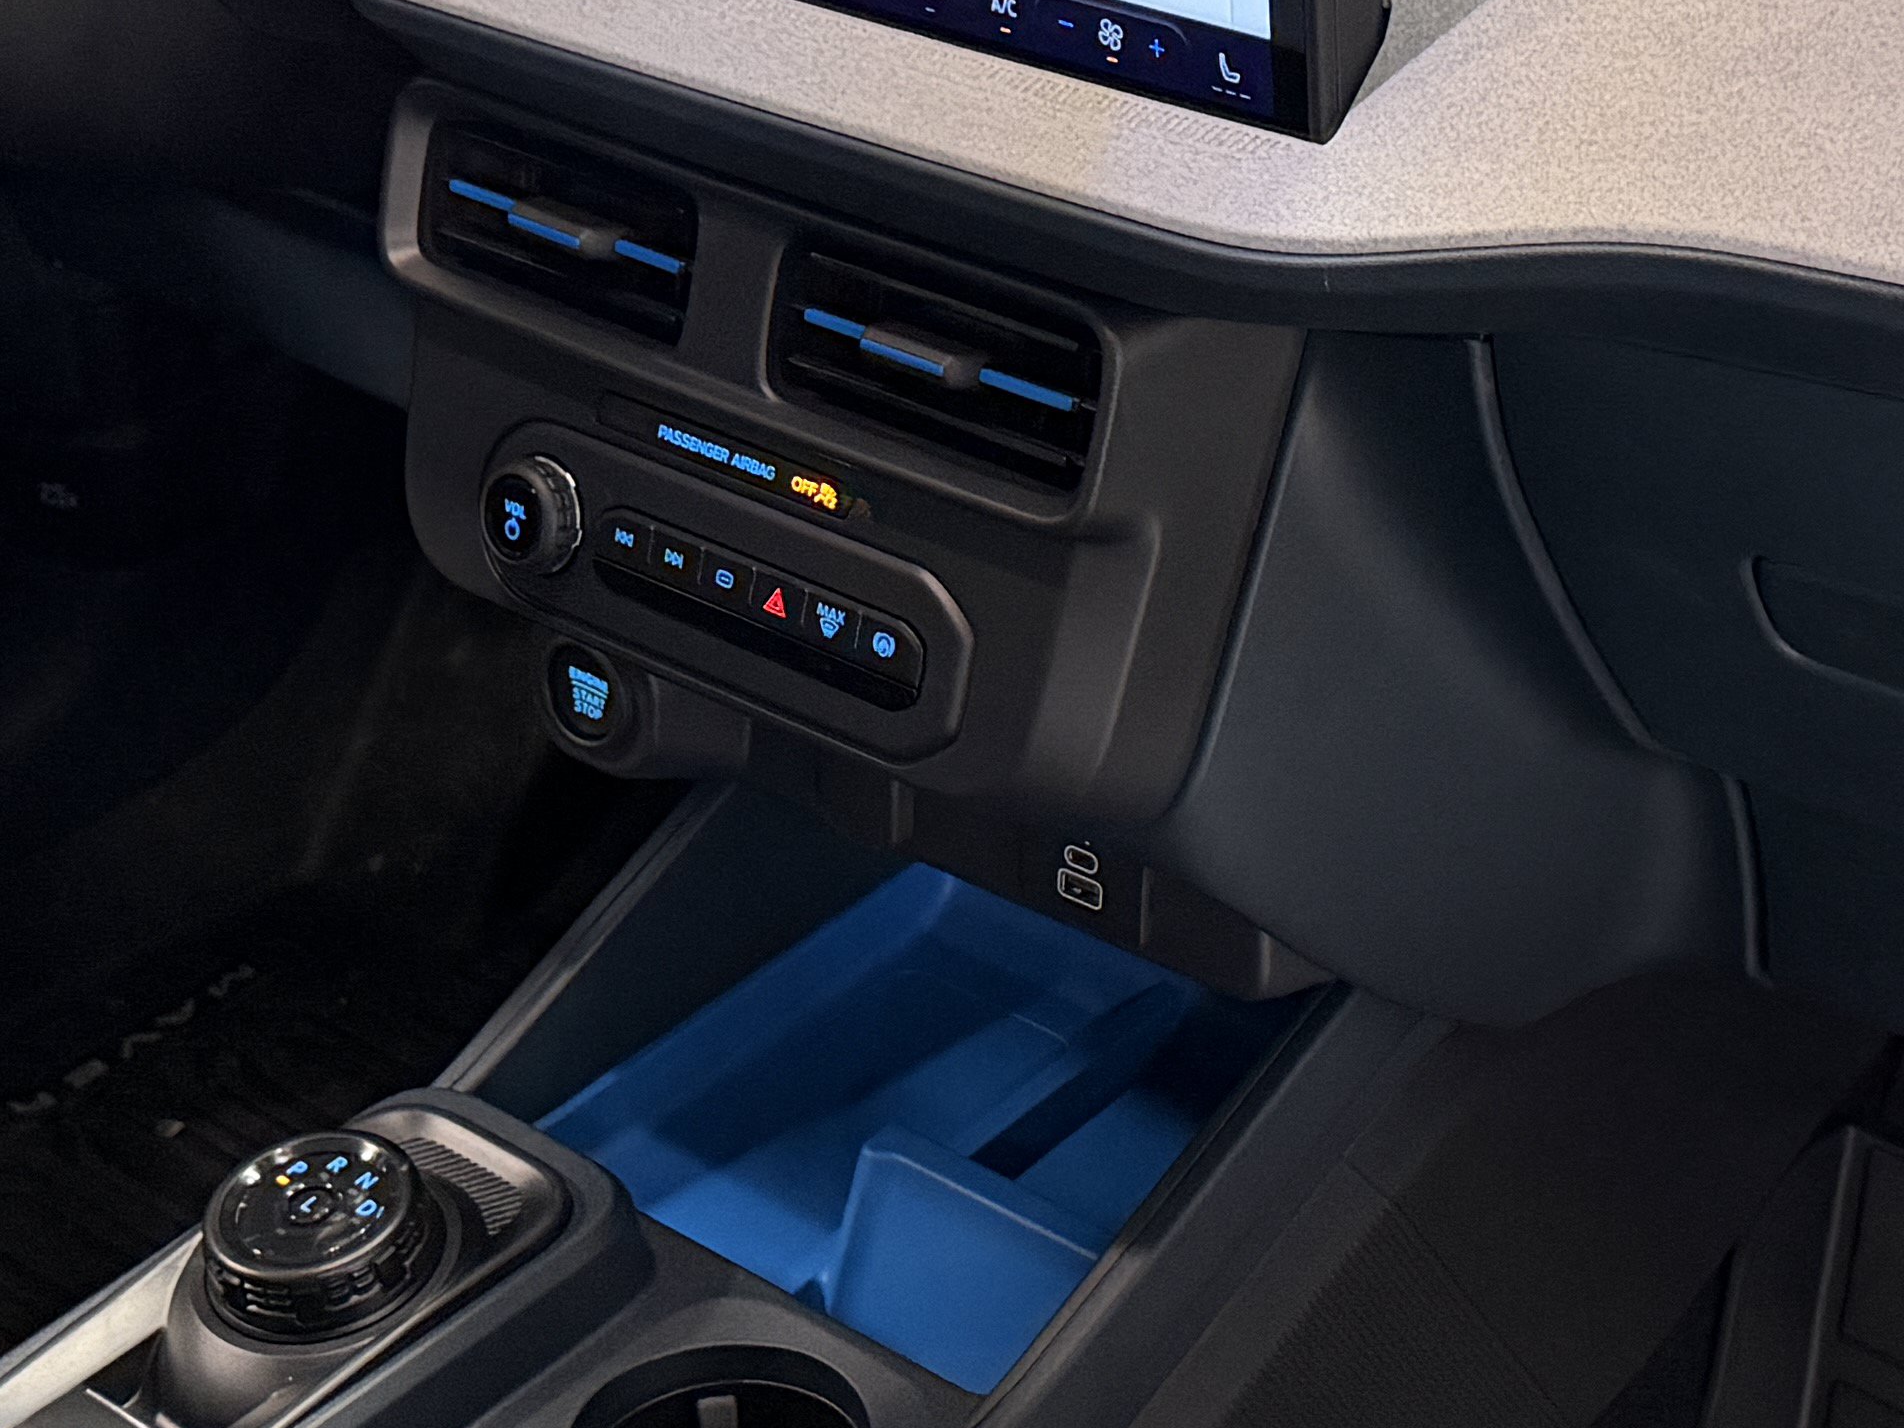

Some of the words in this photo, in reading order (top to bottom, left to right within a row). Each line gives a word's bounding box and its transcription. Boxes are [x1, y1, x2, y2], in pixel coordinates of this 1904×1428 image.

[657, 424, 730, 464] PASSENGER
[731, 453, 776, 481] AIRBAG
[791, 475, 818, 497] OFF
[504, 498, 527, 521] VOL
[816, 602, 846, 626] MAX
[572, 687, 606, 710] START
[574, 700, 603, 721] STOP
[285, 1160, 309, 1175] P
[325, 1155, 349, 1174] R
[353, 1171, 380, 1190] N
[299, 1195, 317, 1213] L
[354, 1198, 378, 1217] D
